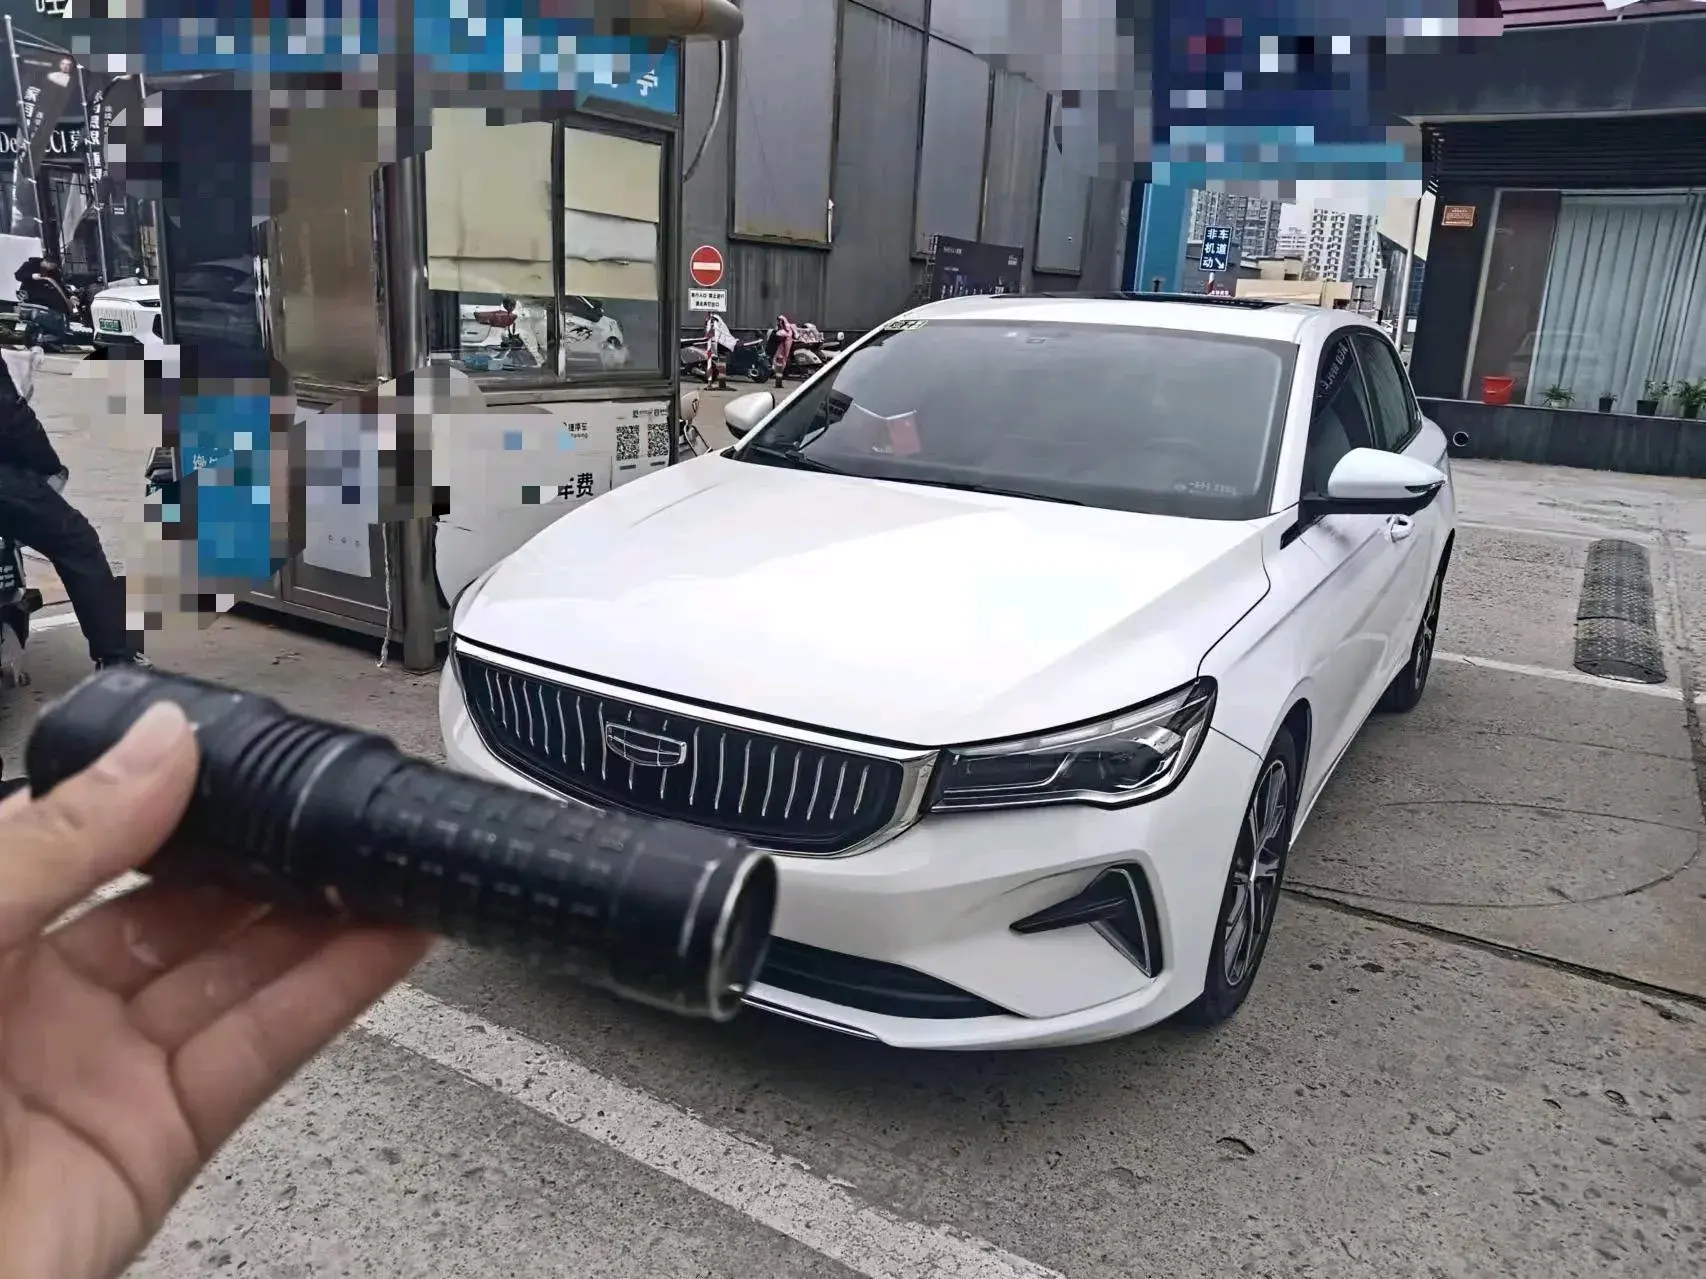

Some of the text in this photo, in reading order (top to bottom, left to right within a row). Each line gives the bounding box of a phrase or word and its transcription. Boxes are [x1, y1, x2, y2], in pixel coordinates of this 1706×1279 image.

[1203, 229, 1217, 268] 非机动
[1216, 229, 1229, 255] 车道
